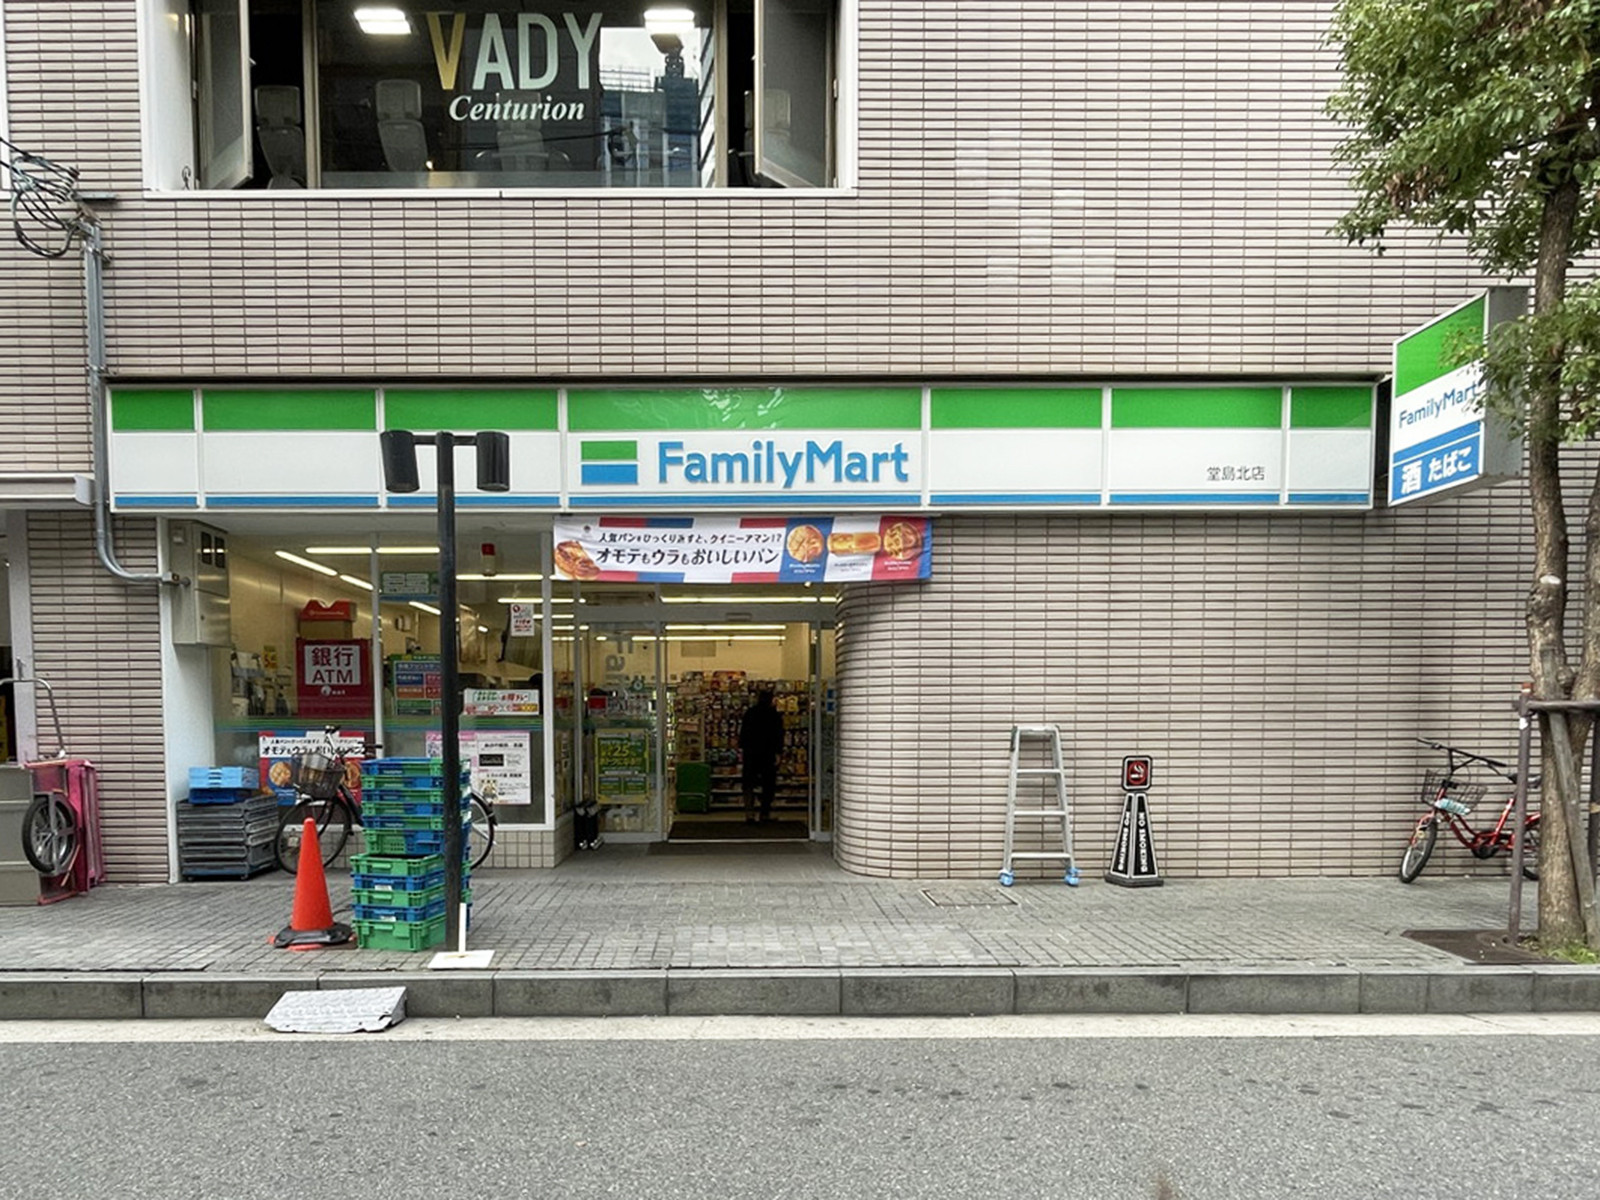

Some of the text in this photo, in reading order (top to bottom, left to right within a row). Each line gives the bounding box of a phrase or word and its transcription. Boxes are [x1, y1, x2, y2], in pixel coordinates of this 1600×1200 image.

[426, 12, 603, 90] VADY
[449, 95, 585, 121] Centurion
[1399, 381, 1480, 429] FamilyMart
[658, 440, 909, 488] FamilyMart
[1207, 466, 1265, 481] 堂島北店
[1401, 446, 1472, 494] 酒 たばこ
[596, 548, 780, 565] オモテもウラもおいしいパン
[311, 647, 354, 667] 銀行
[312, 669, 353, 683] ATM
[1138, 812, 1148, 873] NO SMOKING
